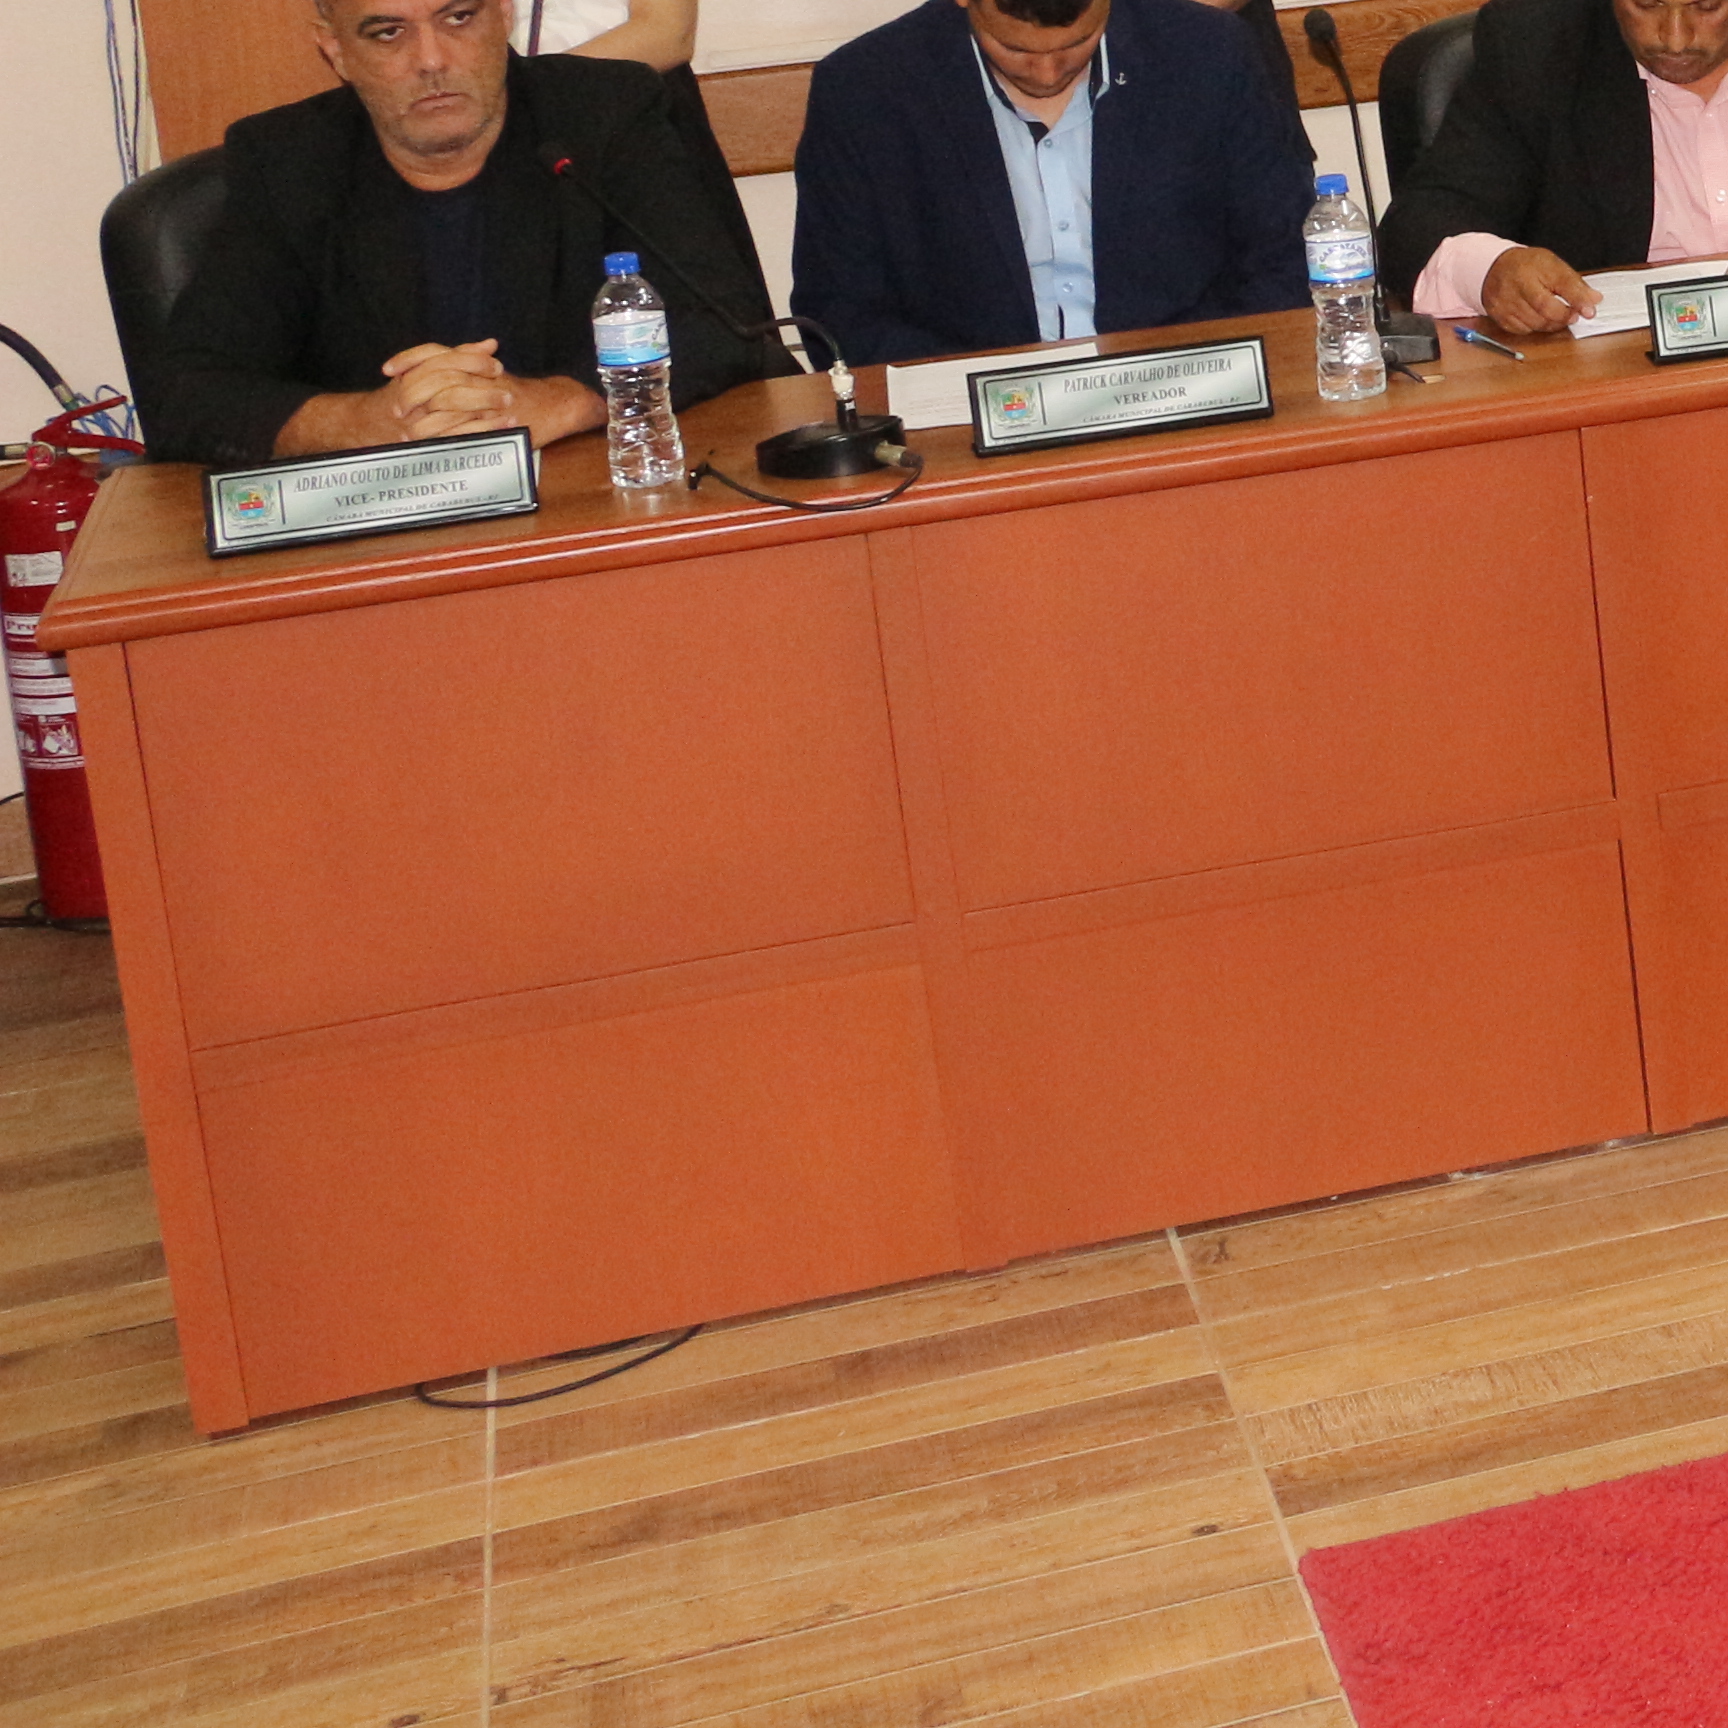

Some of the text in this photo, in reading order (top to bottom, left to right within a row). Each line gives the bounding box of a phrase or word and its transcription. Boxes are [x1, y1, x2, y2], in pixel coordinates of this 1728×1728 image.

[1064, 357, 1233, 393] PATRICK CARVALHO DE OLIVEIRA
[1113, 386, 1188, 406] VEREADOR
[294, 451, 504, 493] ADRIANO COUTO DE LIMA BARCELOS
[378, 479, 468, 502] PRESIDENTE
